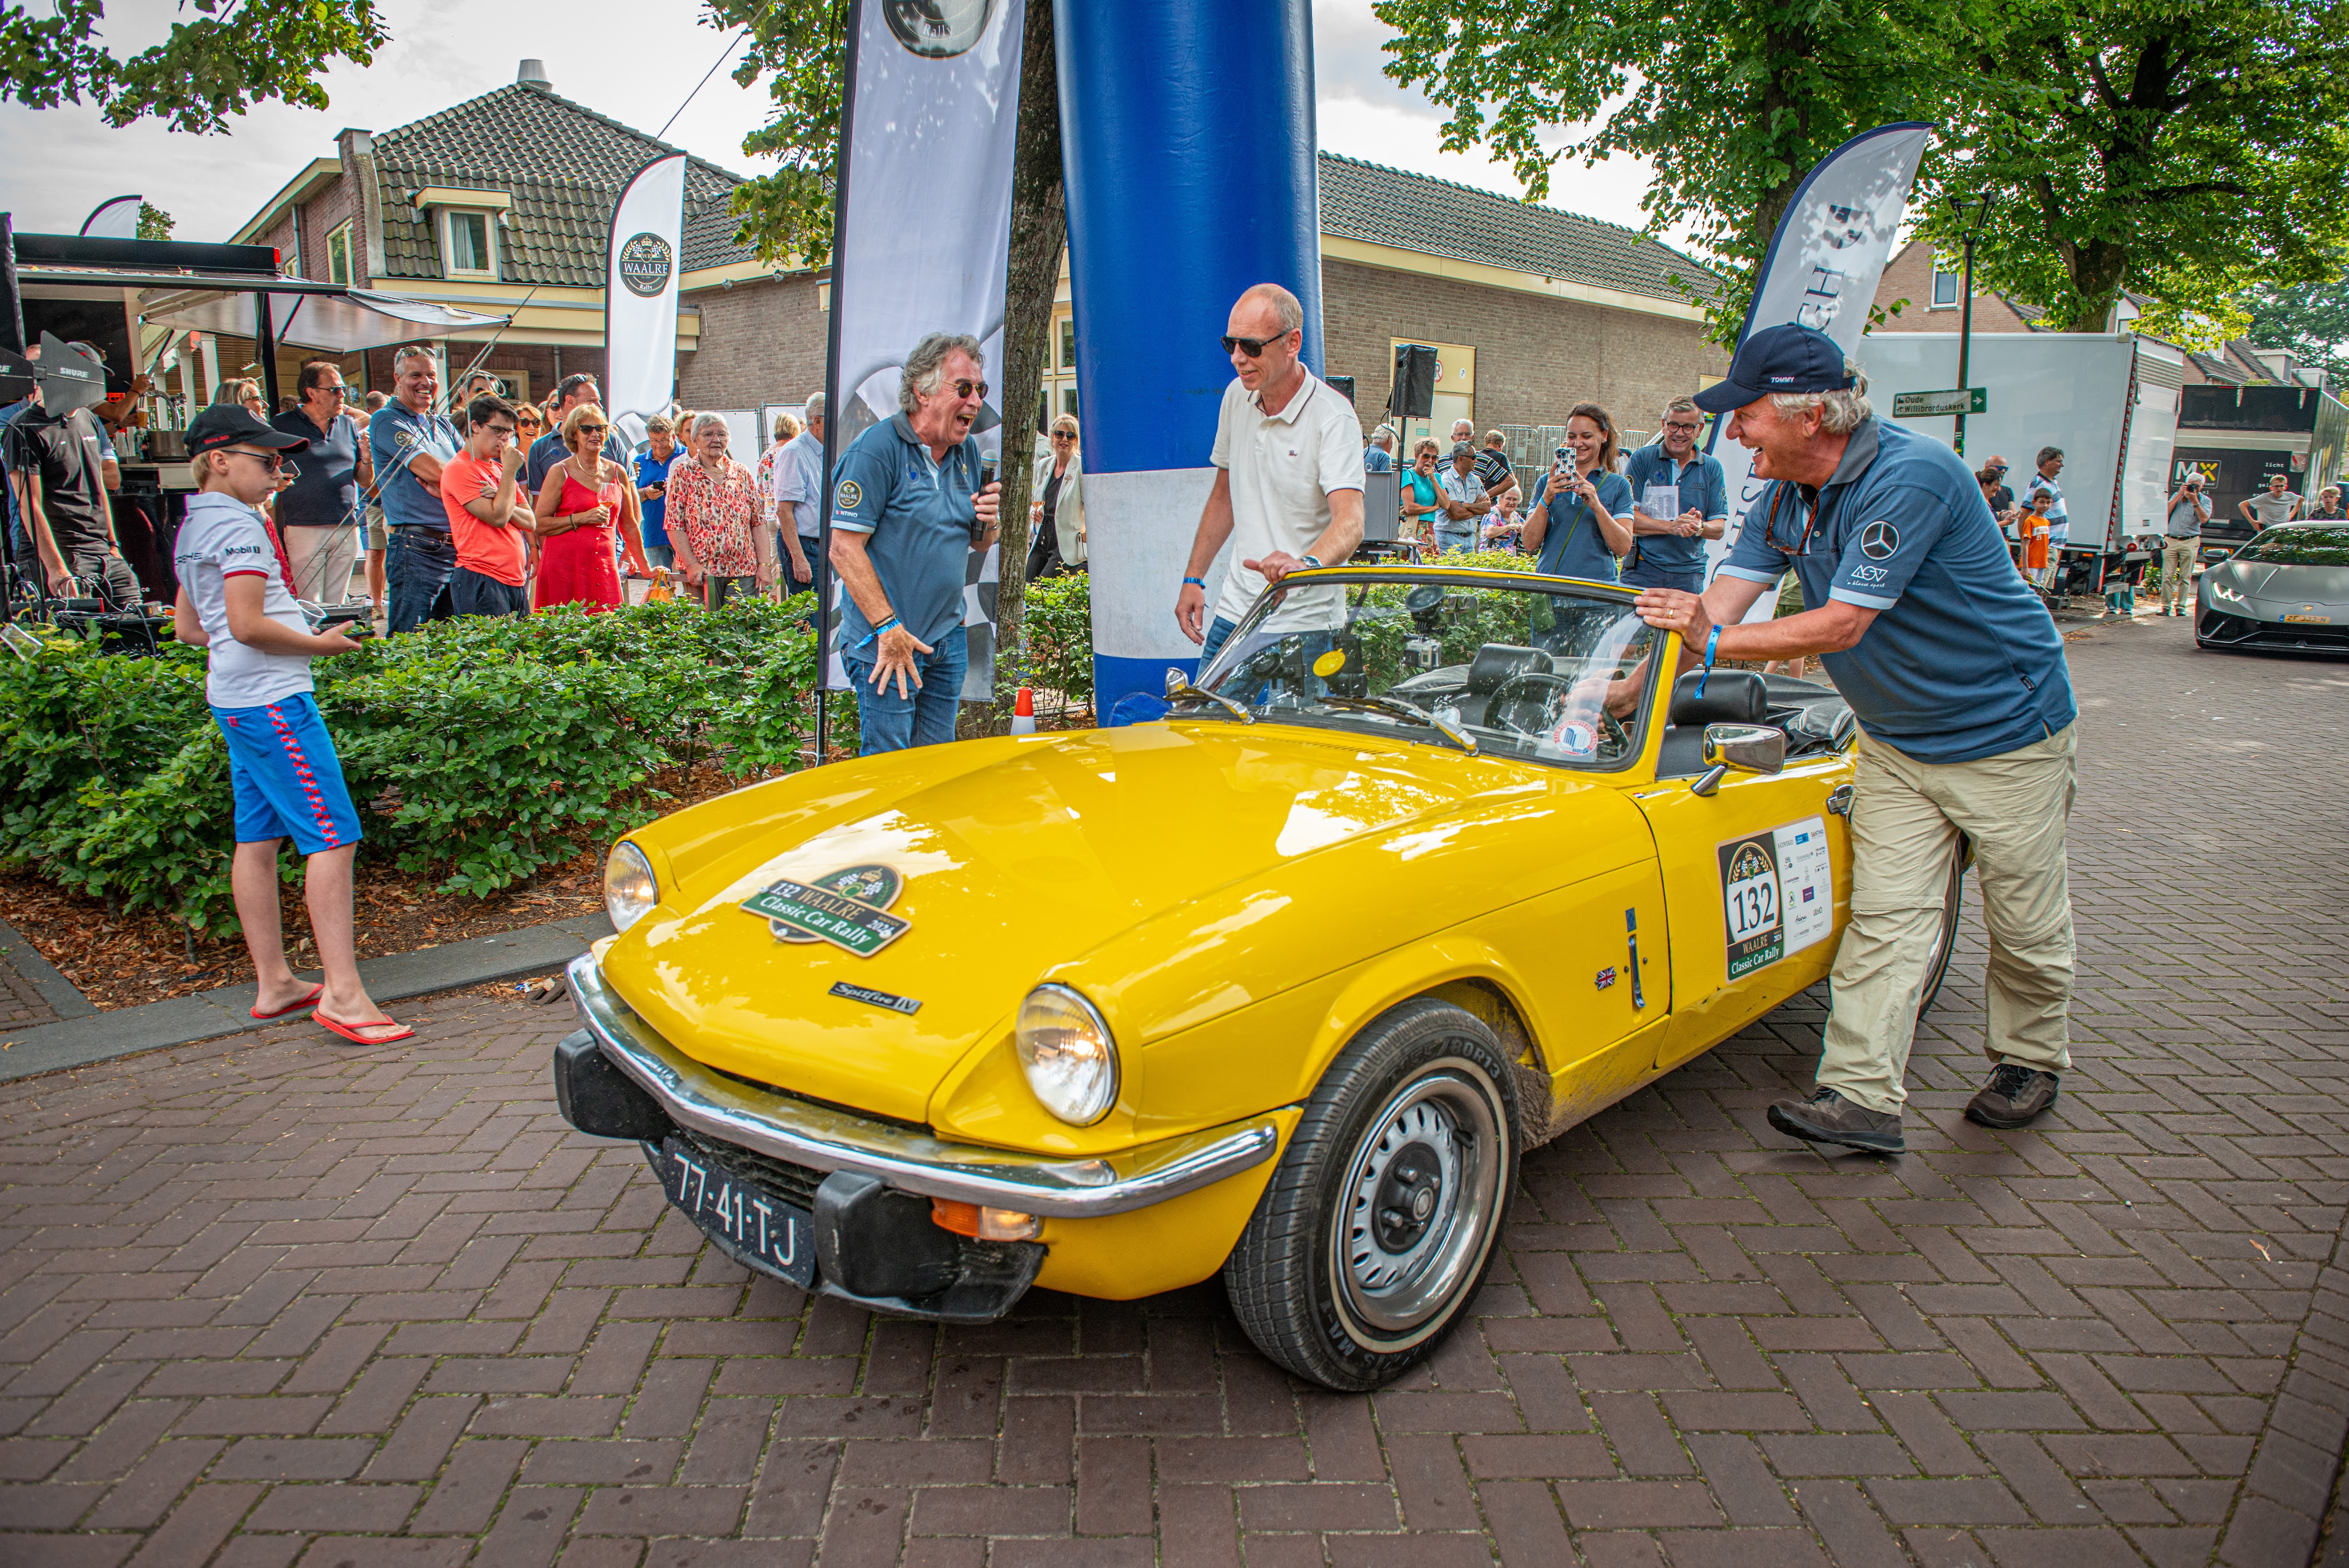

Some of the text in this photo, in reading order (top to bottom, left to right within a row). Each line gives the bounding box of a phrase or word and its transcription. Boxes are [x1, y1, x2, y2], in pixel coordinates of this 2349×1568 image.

[923, 23, 953, 39] Rally
[624, 262, 668, 274] WAALRE
[59, 367, 90, 378] SHURE
[1904, 403, 1965, 413] Willibrorduskerk
[225, 546, 252, 556] Mobil
[770, 882, 802, 898] 132
[797, 890, 866, 921] WAALRE
[1733, 882, 1775, 934] 132
[760, 896, 807, 918] Classic
[804, 911, 832, 928] Car
[828, 920, 872, 946] Rally
[1743, 933, 1782, 955] WAALRE 2024
[1731, 946, 1780, 974] Classic Car Rally
[834, 983, 894, 1005] Spitfire
